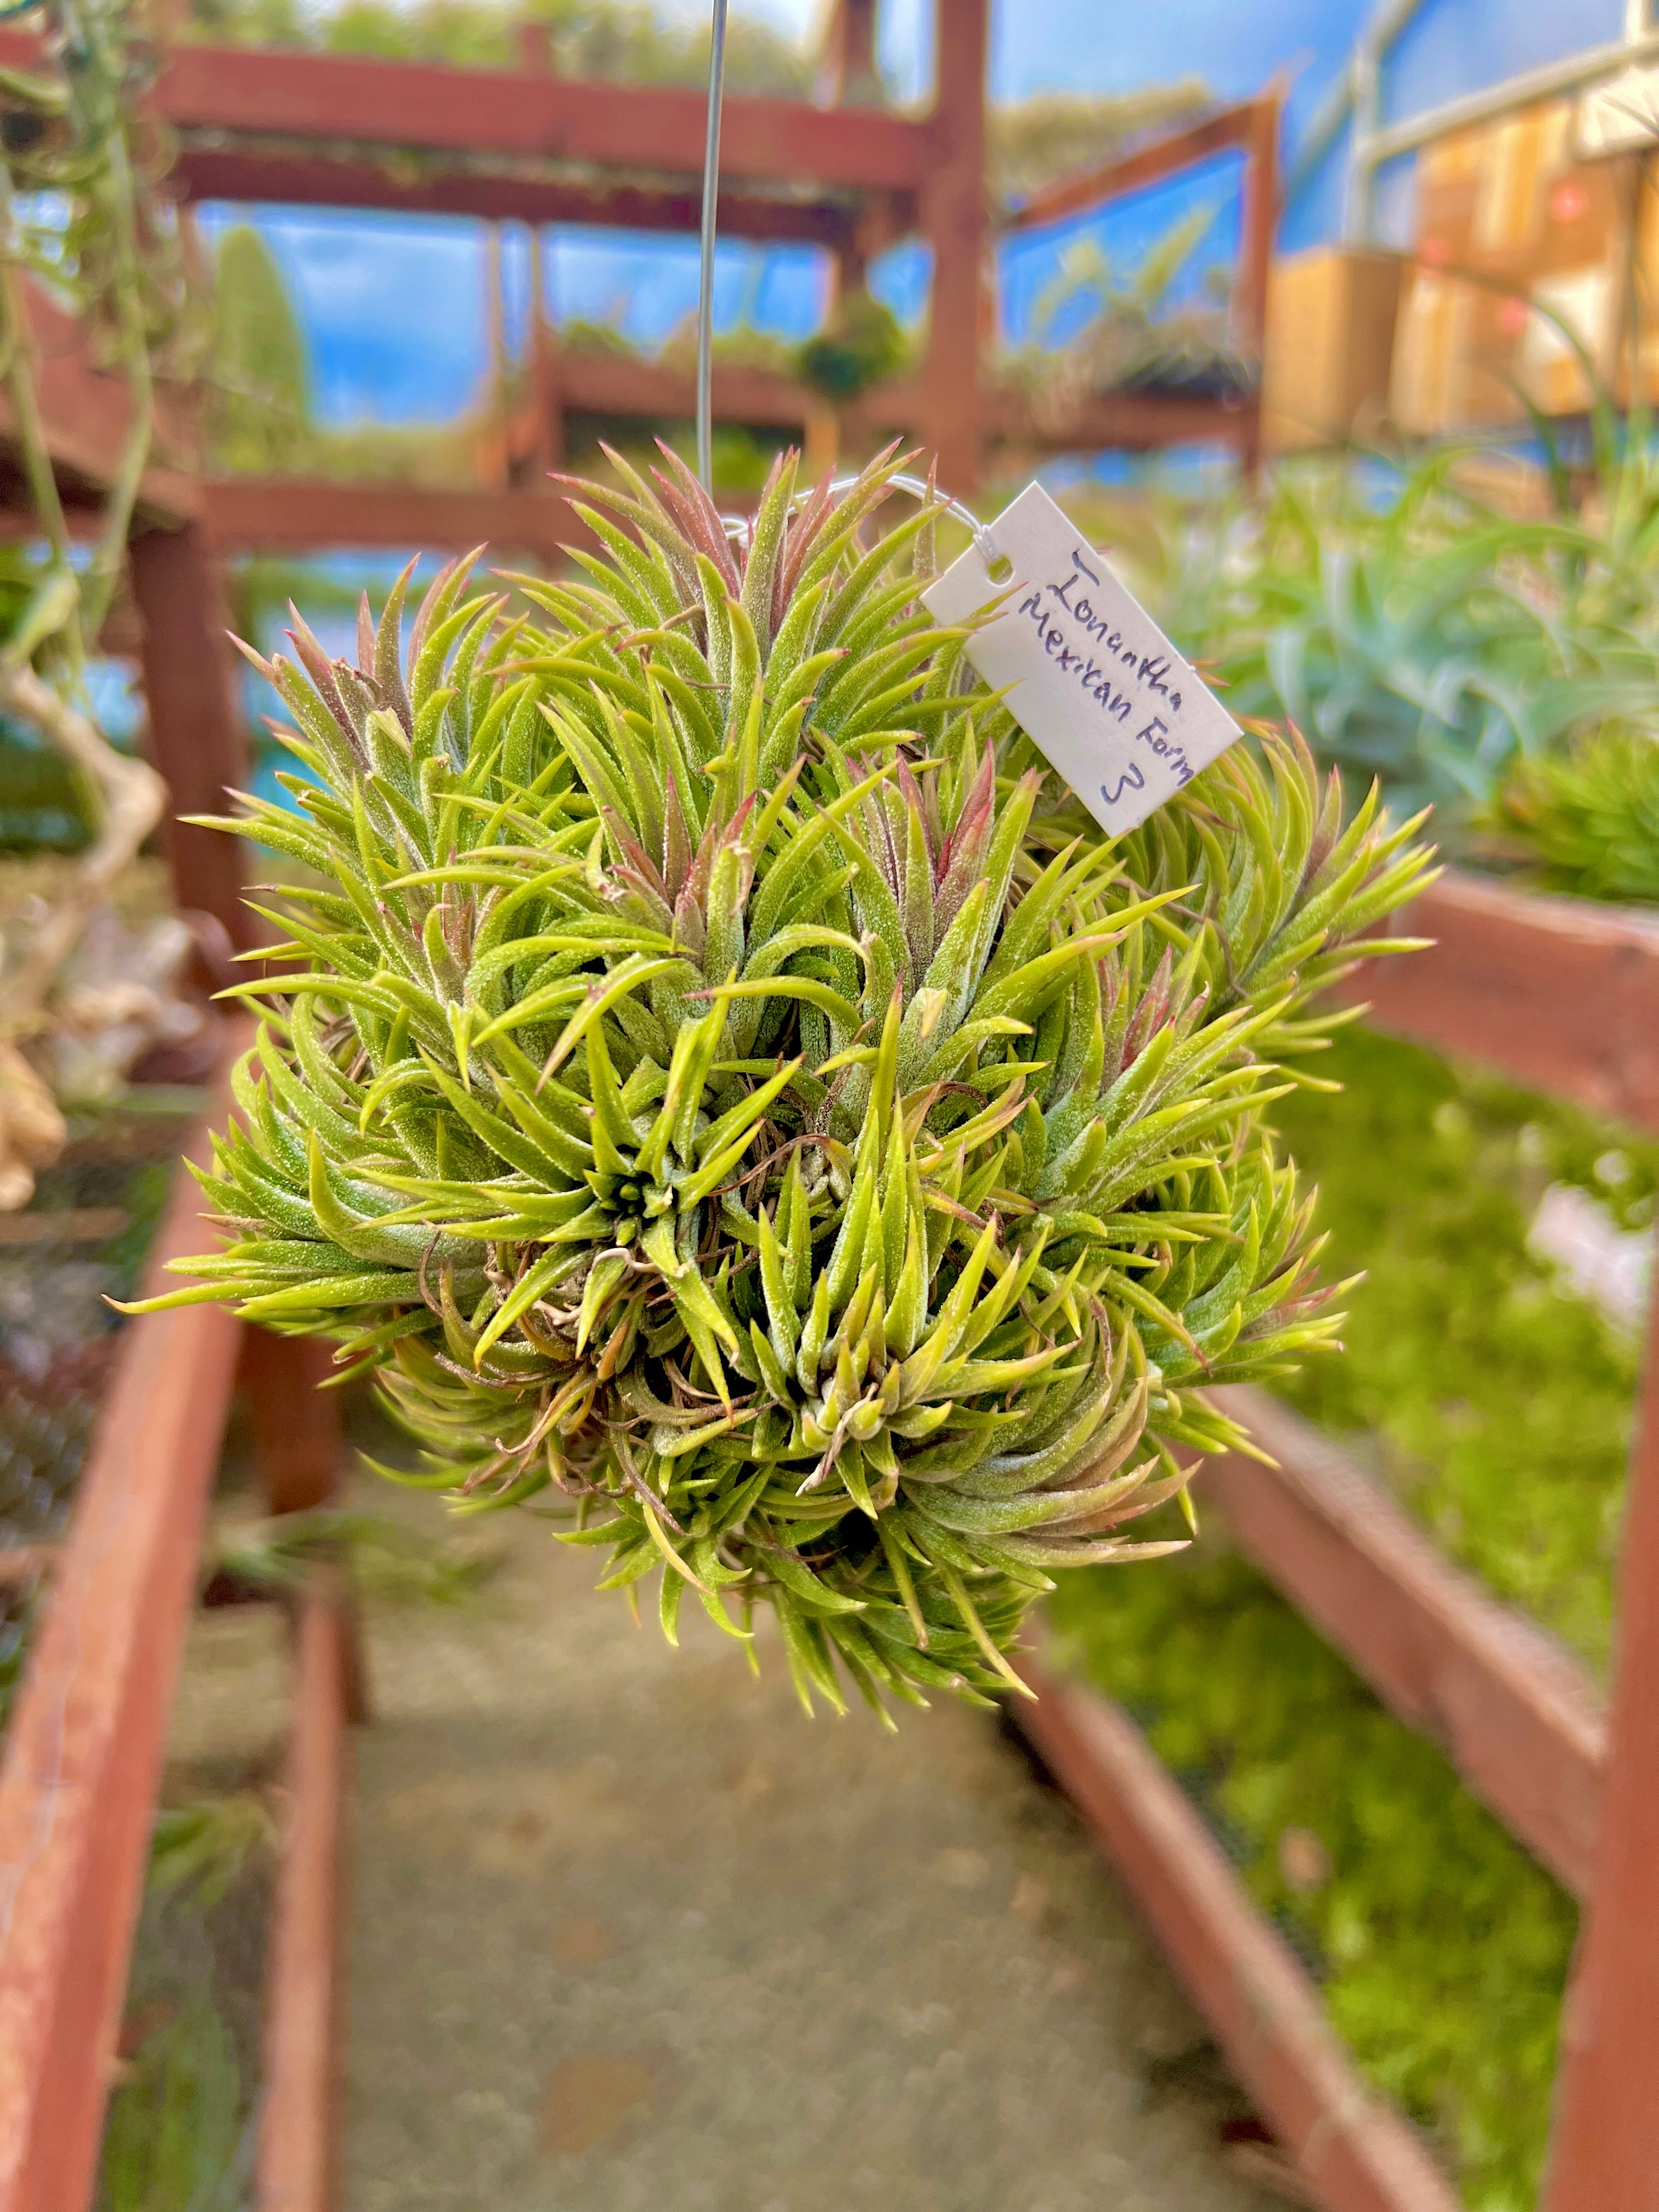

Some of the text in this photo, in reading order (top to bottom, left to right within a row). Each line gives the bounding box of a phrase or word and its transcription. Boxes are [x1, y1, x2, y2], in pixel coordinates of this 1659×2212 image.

[1018, 592, 1194, 787] Mexican Form
[1101, 763, 1145, 805] 3
